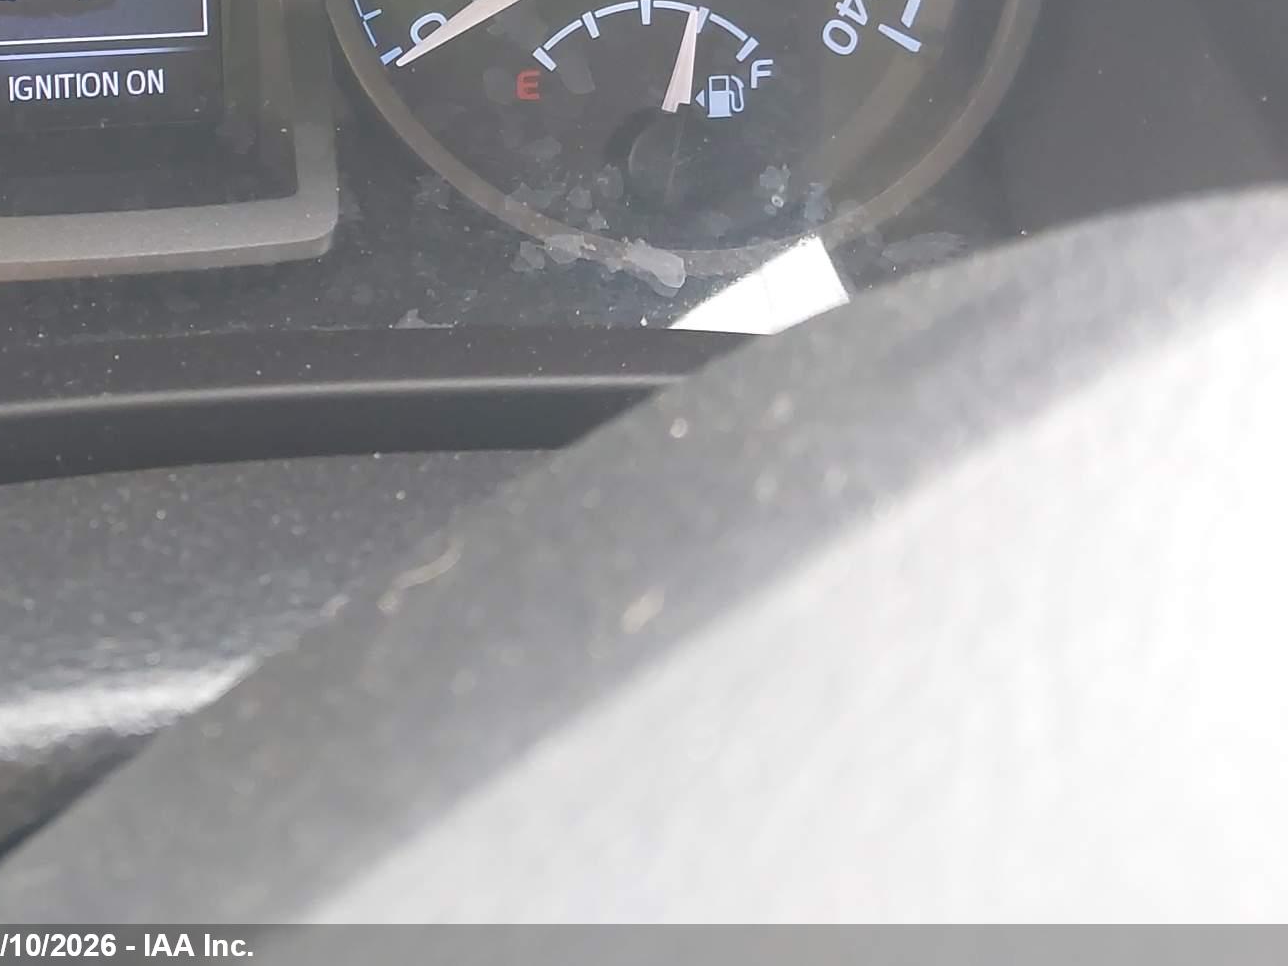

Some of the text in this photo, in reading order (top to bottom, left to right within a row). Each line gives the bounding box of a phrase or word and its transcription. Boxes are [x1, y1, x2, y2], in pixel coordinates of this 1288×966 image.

[8, 68, 164, 102] IGNITION ON
[516, 69, 541, 100] E
[750, 59, 774, 89] F
